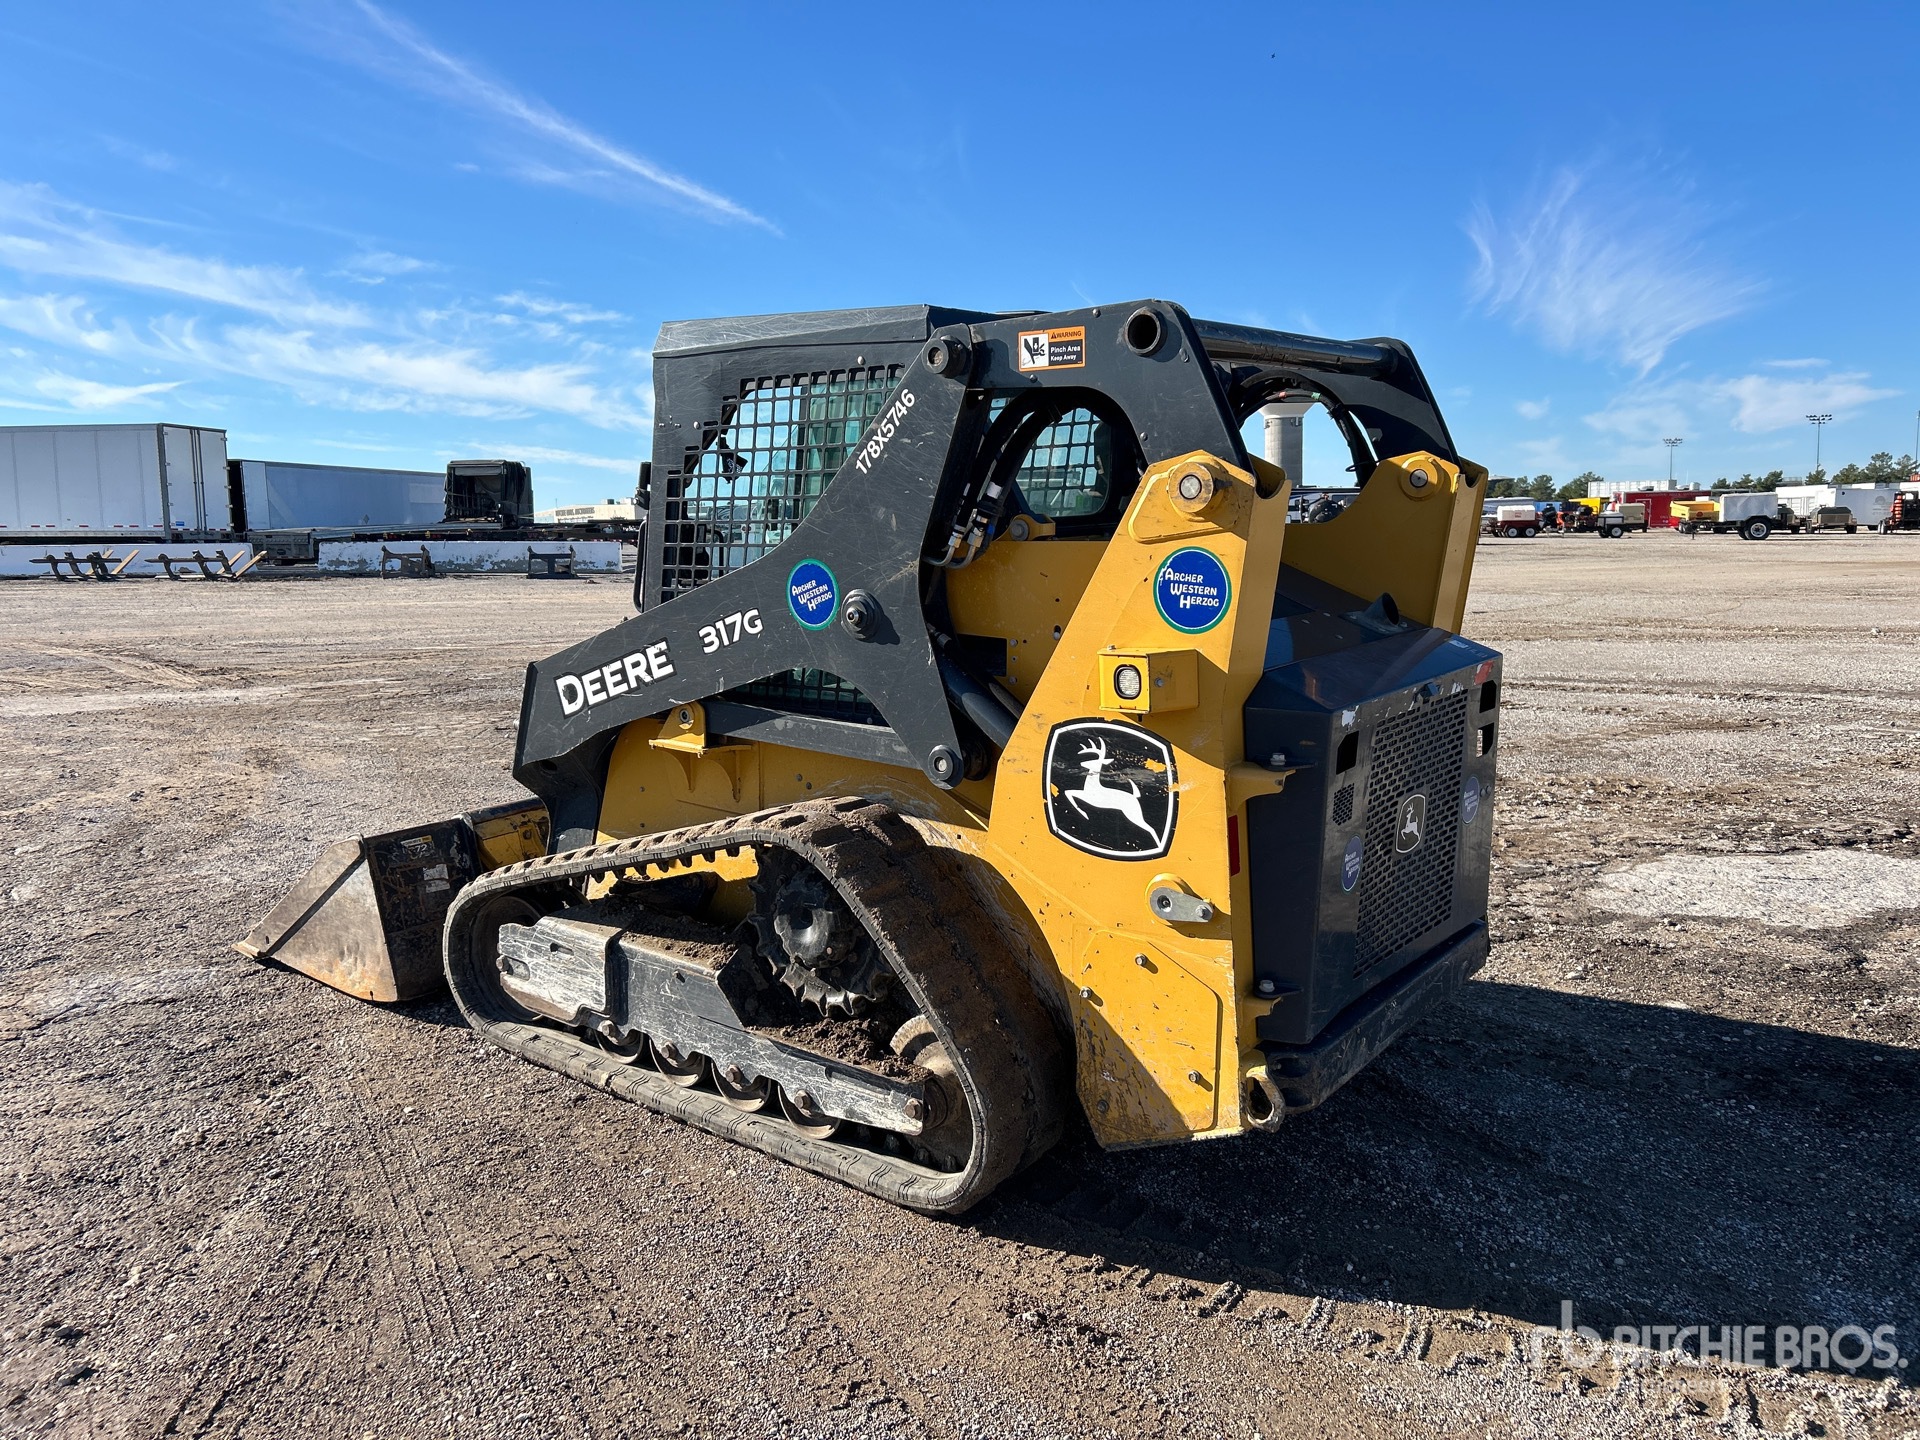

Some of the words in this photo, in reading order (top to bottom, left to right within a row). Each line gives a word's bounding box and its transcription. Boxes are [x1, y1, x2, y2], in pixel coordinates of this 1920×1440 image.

[855, 389, 915, 474] 178X5746
[1165, 567, 1203, 583] ARCHER
[791, 580, 817, 596] ARCHER
[797, 584, 829, 605] WESTERN
[1170, 583, 1217, 596] WESTERN
[807, 591, 833, 611] HERZOG
[1179, 594, 1220, 609] HERZOG
[698, 608, 764, 654] 317G
[555, 640, 674, 716] DEERE
